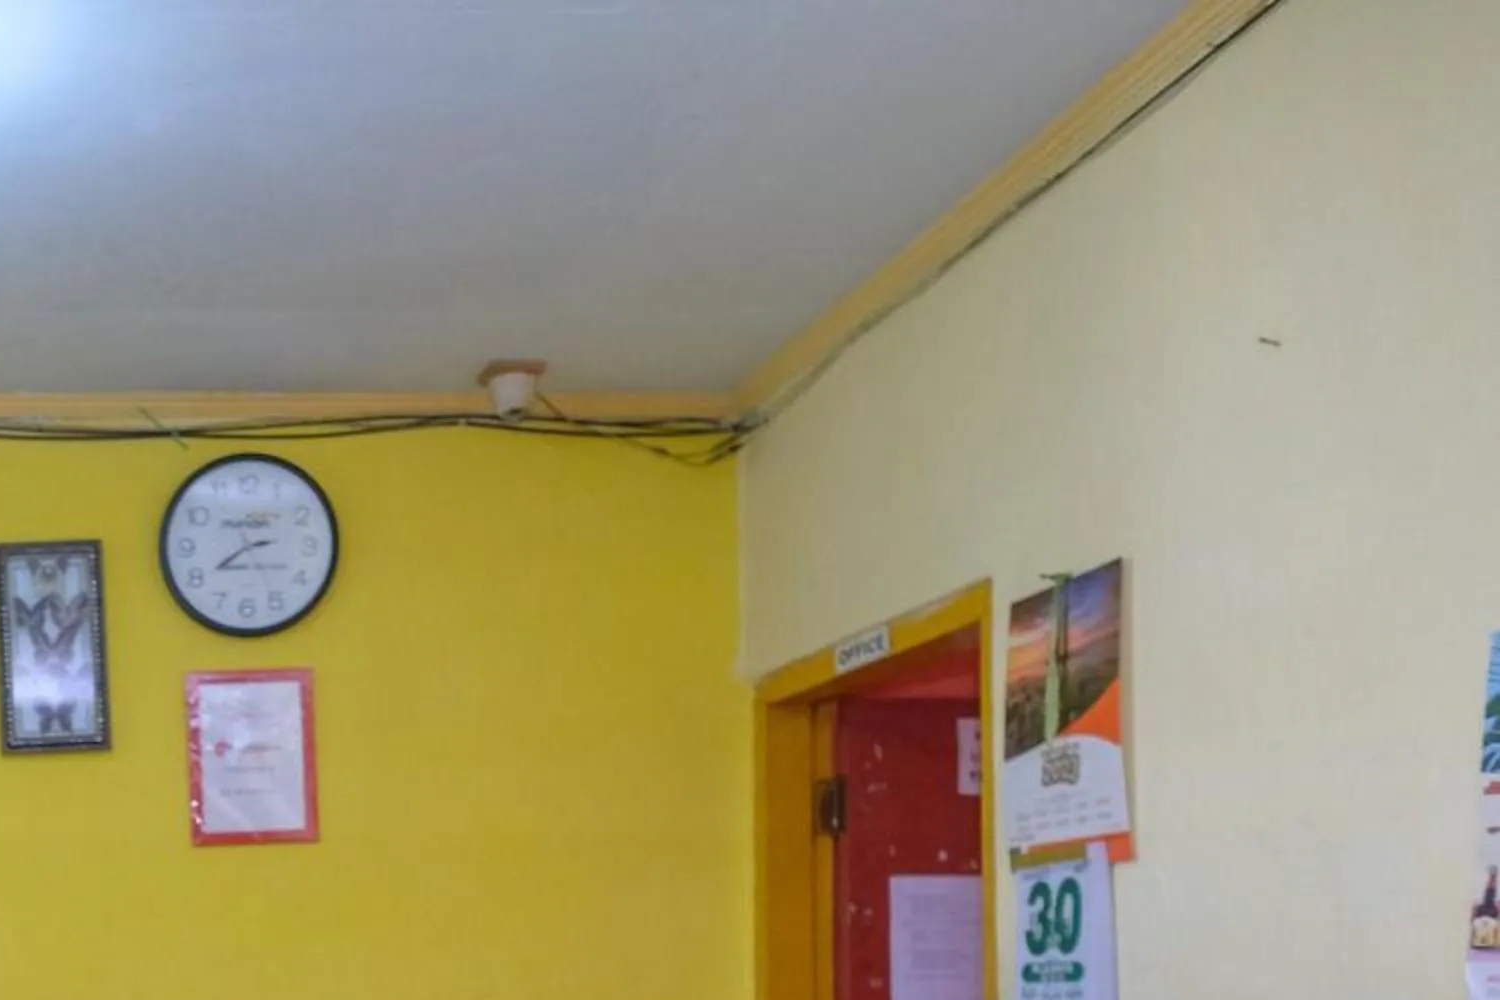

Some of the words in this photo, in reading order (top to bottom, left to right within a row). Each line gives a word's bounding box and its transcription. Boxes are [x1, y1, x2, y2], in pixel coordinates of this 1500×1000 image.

[187, 506, 210, 527] 10
[293, 504, 311, 527] 2
[178, 537, 196, 558] 9
[301, 535, 318, 557] 3
[187, 567, 204, 588] 8
[291, 569, 307, 587] 4
[212, 592, 229, 610] 7
[238, 597, 257, 618] 6
[268, 591, 285, 612] 5
[1025, 878, 1082, 956] 30
